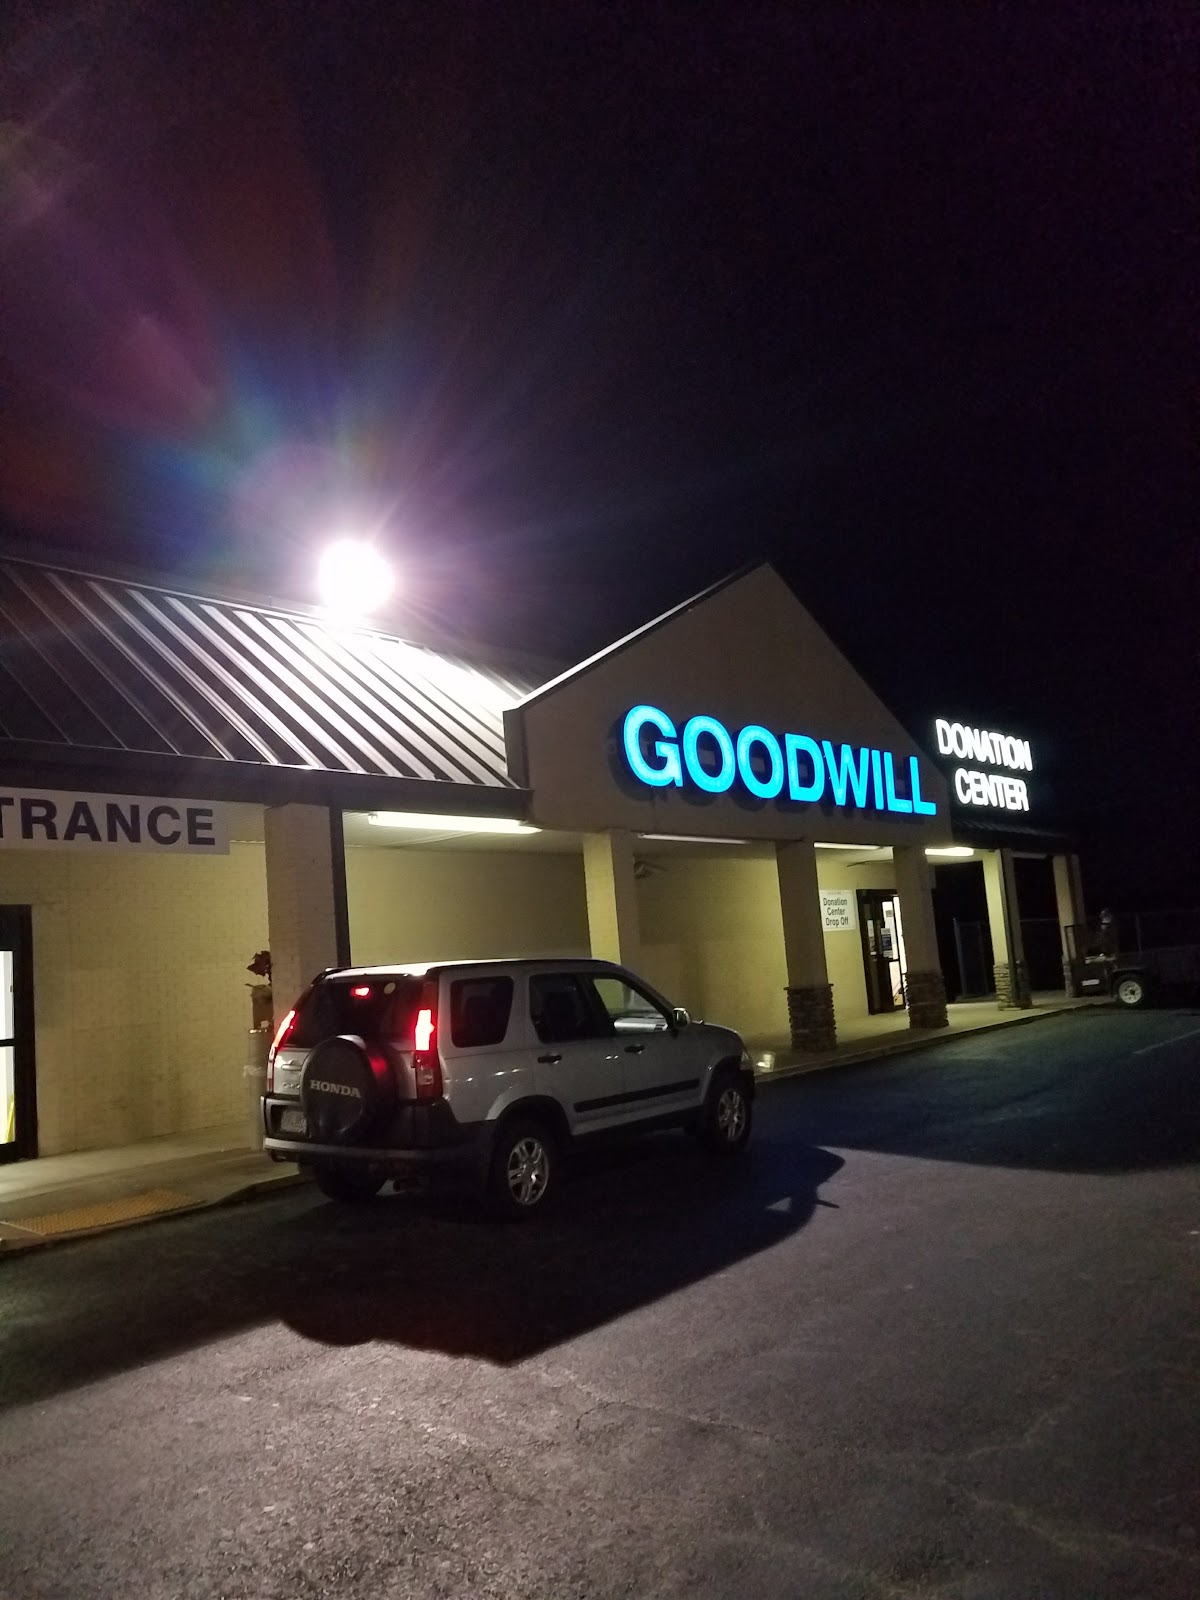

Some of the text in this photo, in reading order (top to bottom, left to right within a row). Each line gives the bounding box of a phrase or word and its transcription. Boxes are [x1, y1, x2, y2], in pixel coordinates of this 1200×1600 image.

[935, 718, 1034, 771] DONATION
[622, 704, 937, 816] GOODWILL
[954, 768, 1031, 812] CENTER
[823, 897, 848, 906] Donation
[827, 907, 846, 916] Center
[825, 916, 849, 928] Drop Off
[309, 1079, 361, 1099] HONDA
